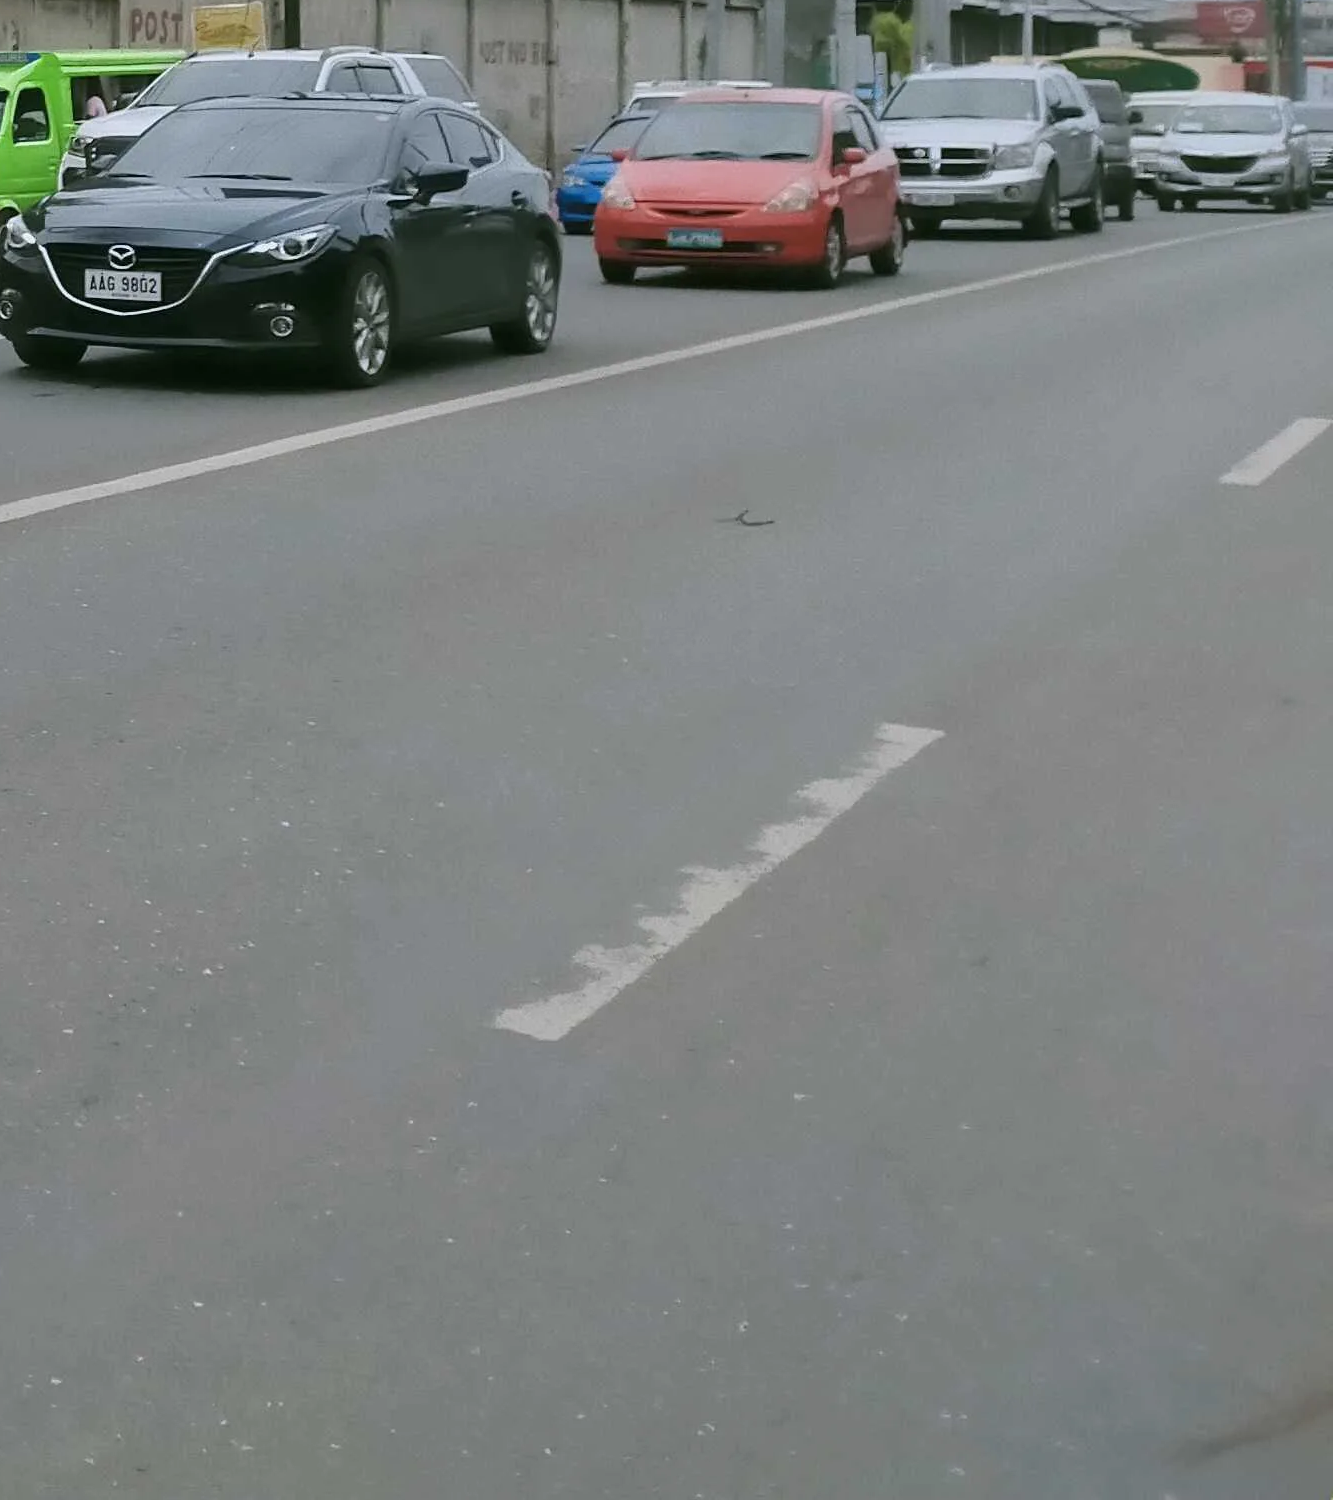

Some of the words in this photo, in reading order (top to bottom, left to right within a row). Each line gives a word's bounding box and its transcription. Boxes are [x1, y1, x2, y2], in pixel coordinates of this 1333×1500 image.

[130, 7, 183, 45] POST
[90, 274, 115, 291] AAG
[122, 276, 157, 294] 9802
